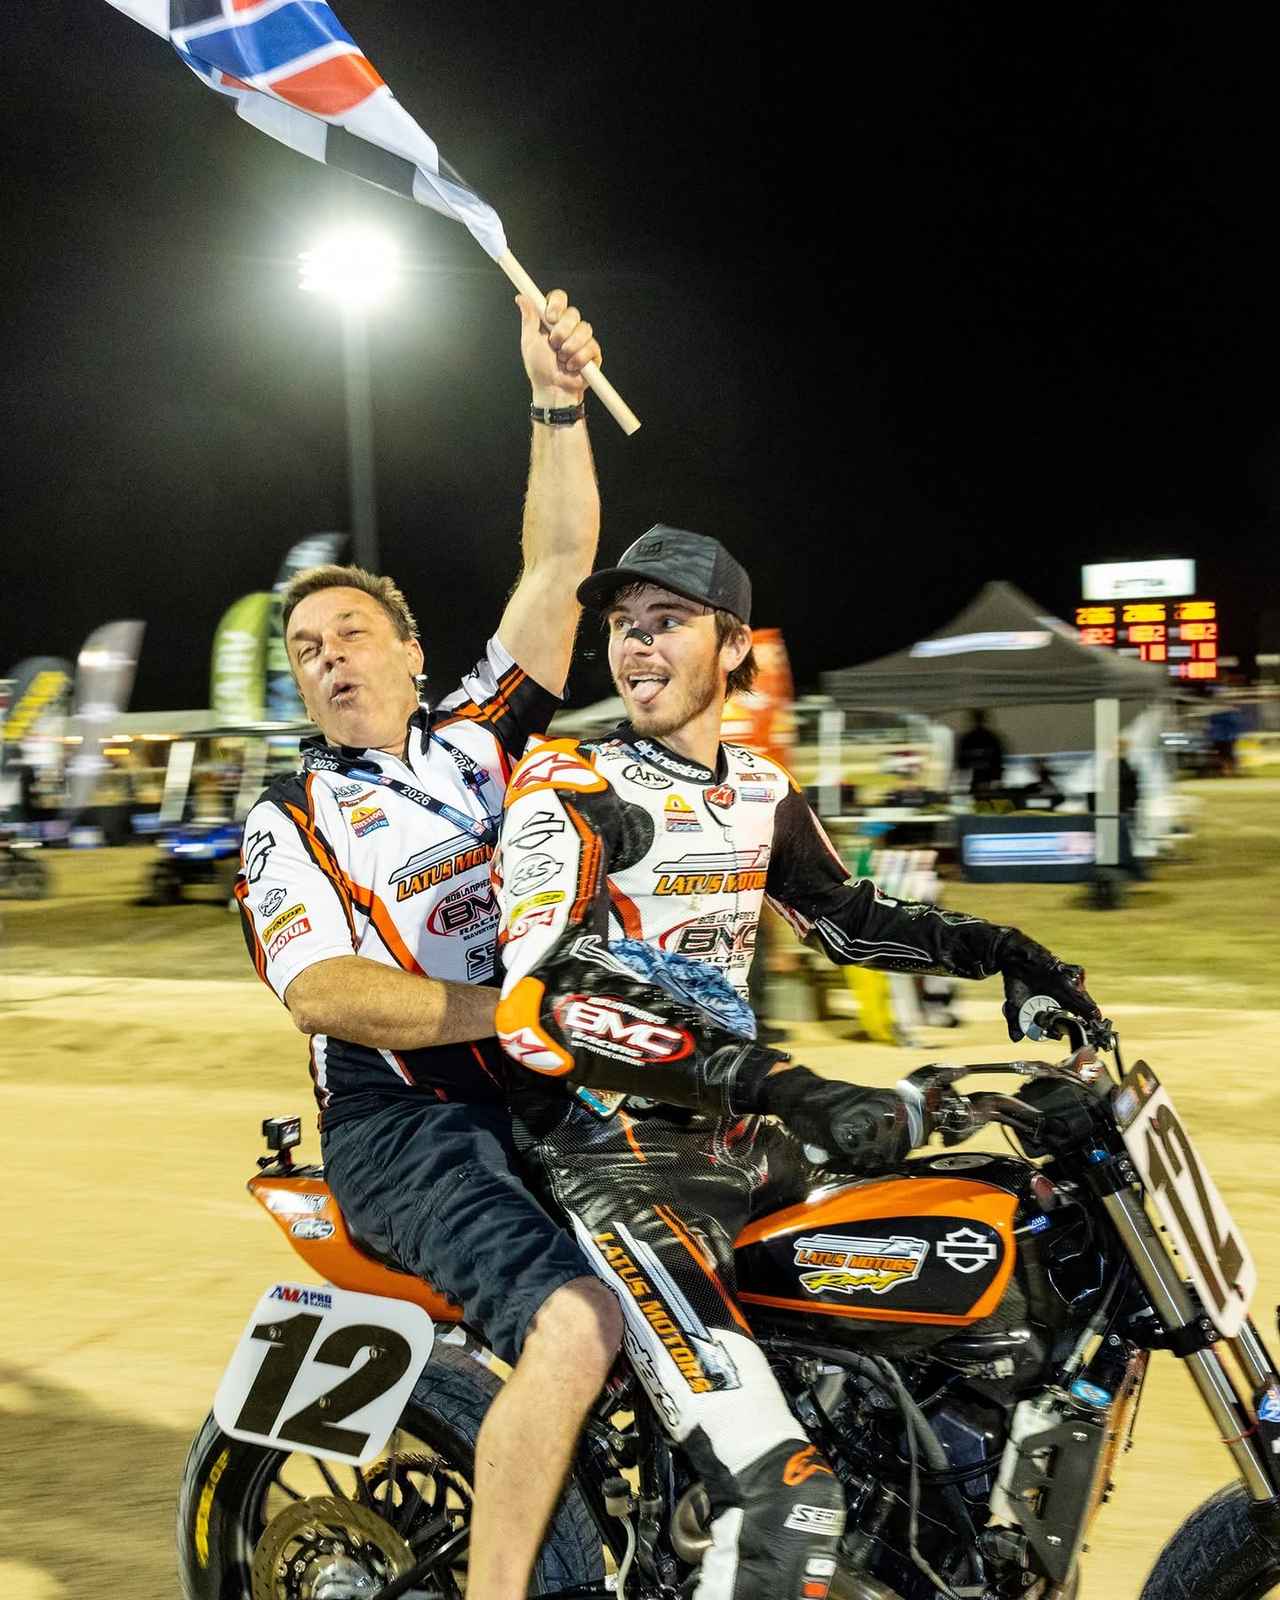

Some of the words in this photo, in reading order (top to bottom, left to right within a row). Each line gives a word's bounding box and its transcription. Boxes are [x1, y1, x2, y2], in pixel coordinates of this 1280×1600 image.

[311, 758, 340, 771] 2026
[634, 740, 712, 781] alpinestars
[401, 785, 432, 806] 2026
[396, 858, 453, 902] LATUS
[653, 873, 725, 896] LATUS
[440, 887, 501, 933] BM
[565, 1001, 684, 1056] BMC
[1146, 1103, 1244, 1314] 12
[799, 1248, 849, 1268] LATUS
[848, 1254, 918, 1273] MOTORS
[269, 1285, 310, 1305] AMA
[310, 1293, 332, 1304] PRO
[593, 1232, 652, 1298] LATUS
[638, 1300, 714, 1394] MOTORS
[234, 1312, 412, 1458] 12
